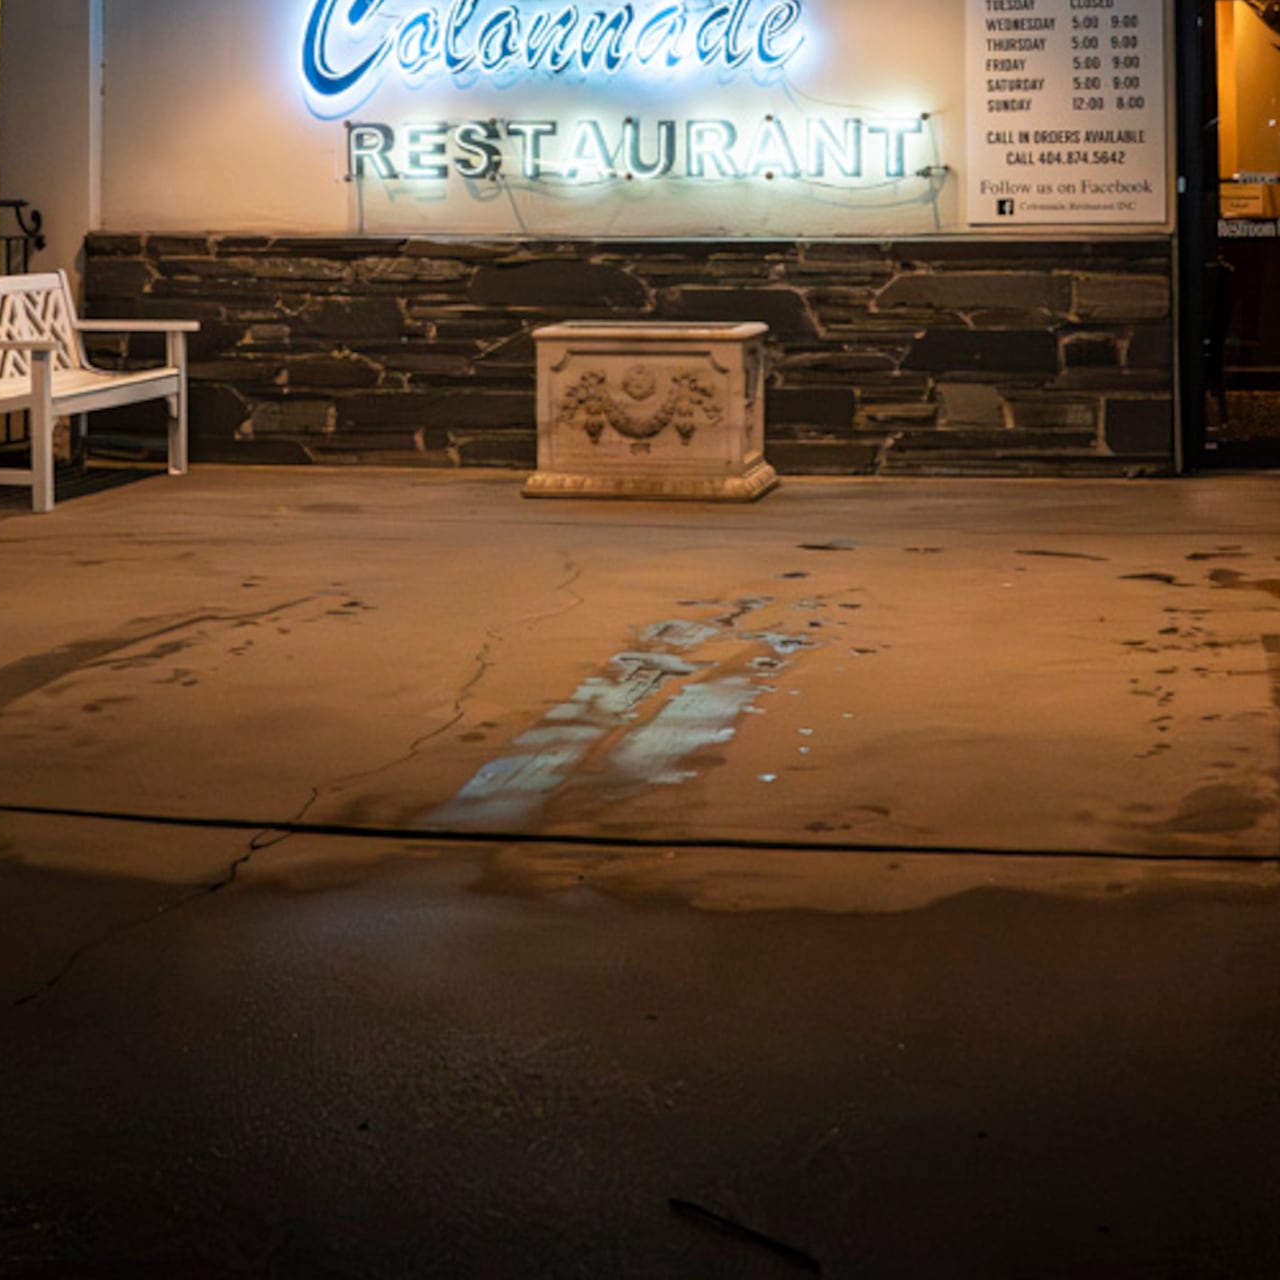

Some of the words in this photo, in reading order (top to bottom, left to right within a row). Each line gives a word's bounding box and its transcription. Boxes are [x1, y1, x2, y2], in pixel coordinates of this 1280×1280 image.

[986, 18, 1055, 31] WEDNESDAY
[1072, 16, 1099, 29] 5:00
[986, 38, 1046, 51] THURSDAY
[1072, 36, 1099, 49] 5:00
[986, 59, 1026, 71] FRIDAY
[1073, 56, 1101, 69] 5:00
[987, 79, 1045, 92] SATURDAY
[1073, 77, 1101, 90] 5:00
[987, 99, 1032, 112] SUNDAY
[1072, 97, 1104, 110] 12:00
[986, 131, 1014, 144] CALL
[1018, 131, 1029, 144] IN
[1034, 130, 1080, 144] ORDERS
[1084, 130, 1145, 144] AVAILABLE
[347, 118, 926, 181] RESTAURANT
[1006, 152, 1034, 164] CALL
[1038, 151, 1126, 165] 404.874.5642
[980, 180, 1032, 194] Follow
[1036, 182, 1052, 194] us
[1057, 182, 1076, 194] on
[1081, 179, 1152, 194] Facebook
[1217, 220, 1276, 237] Restroom
